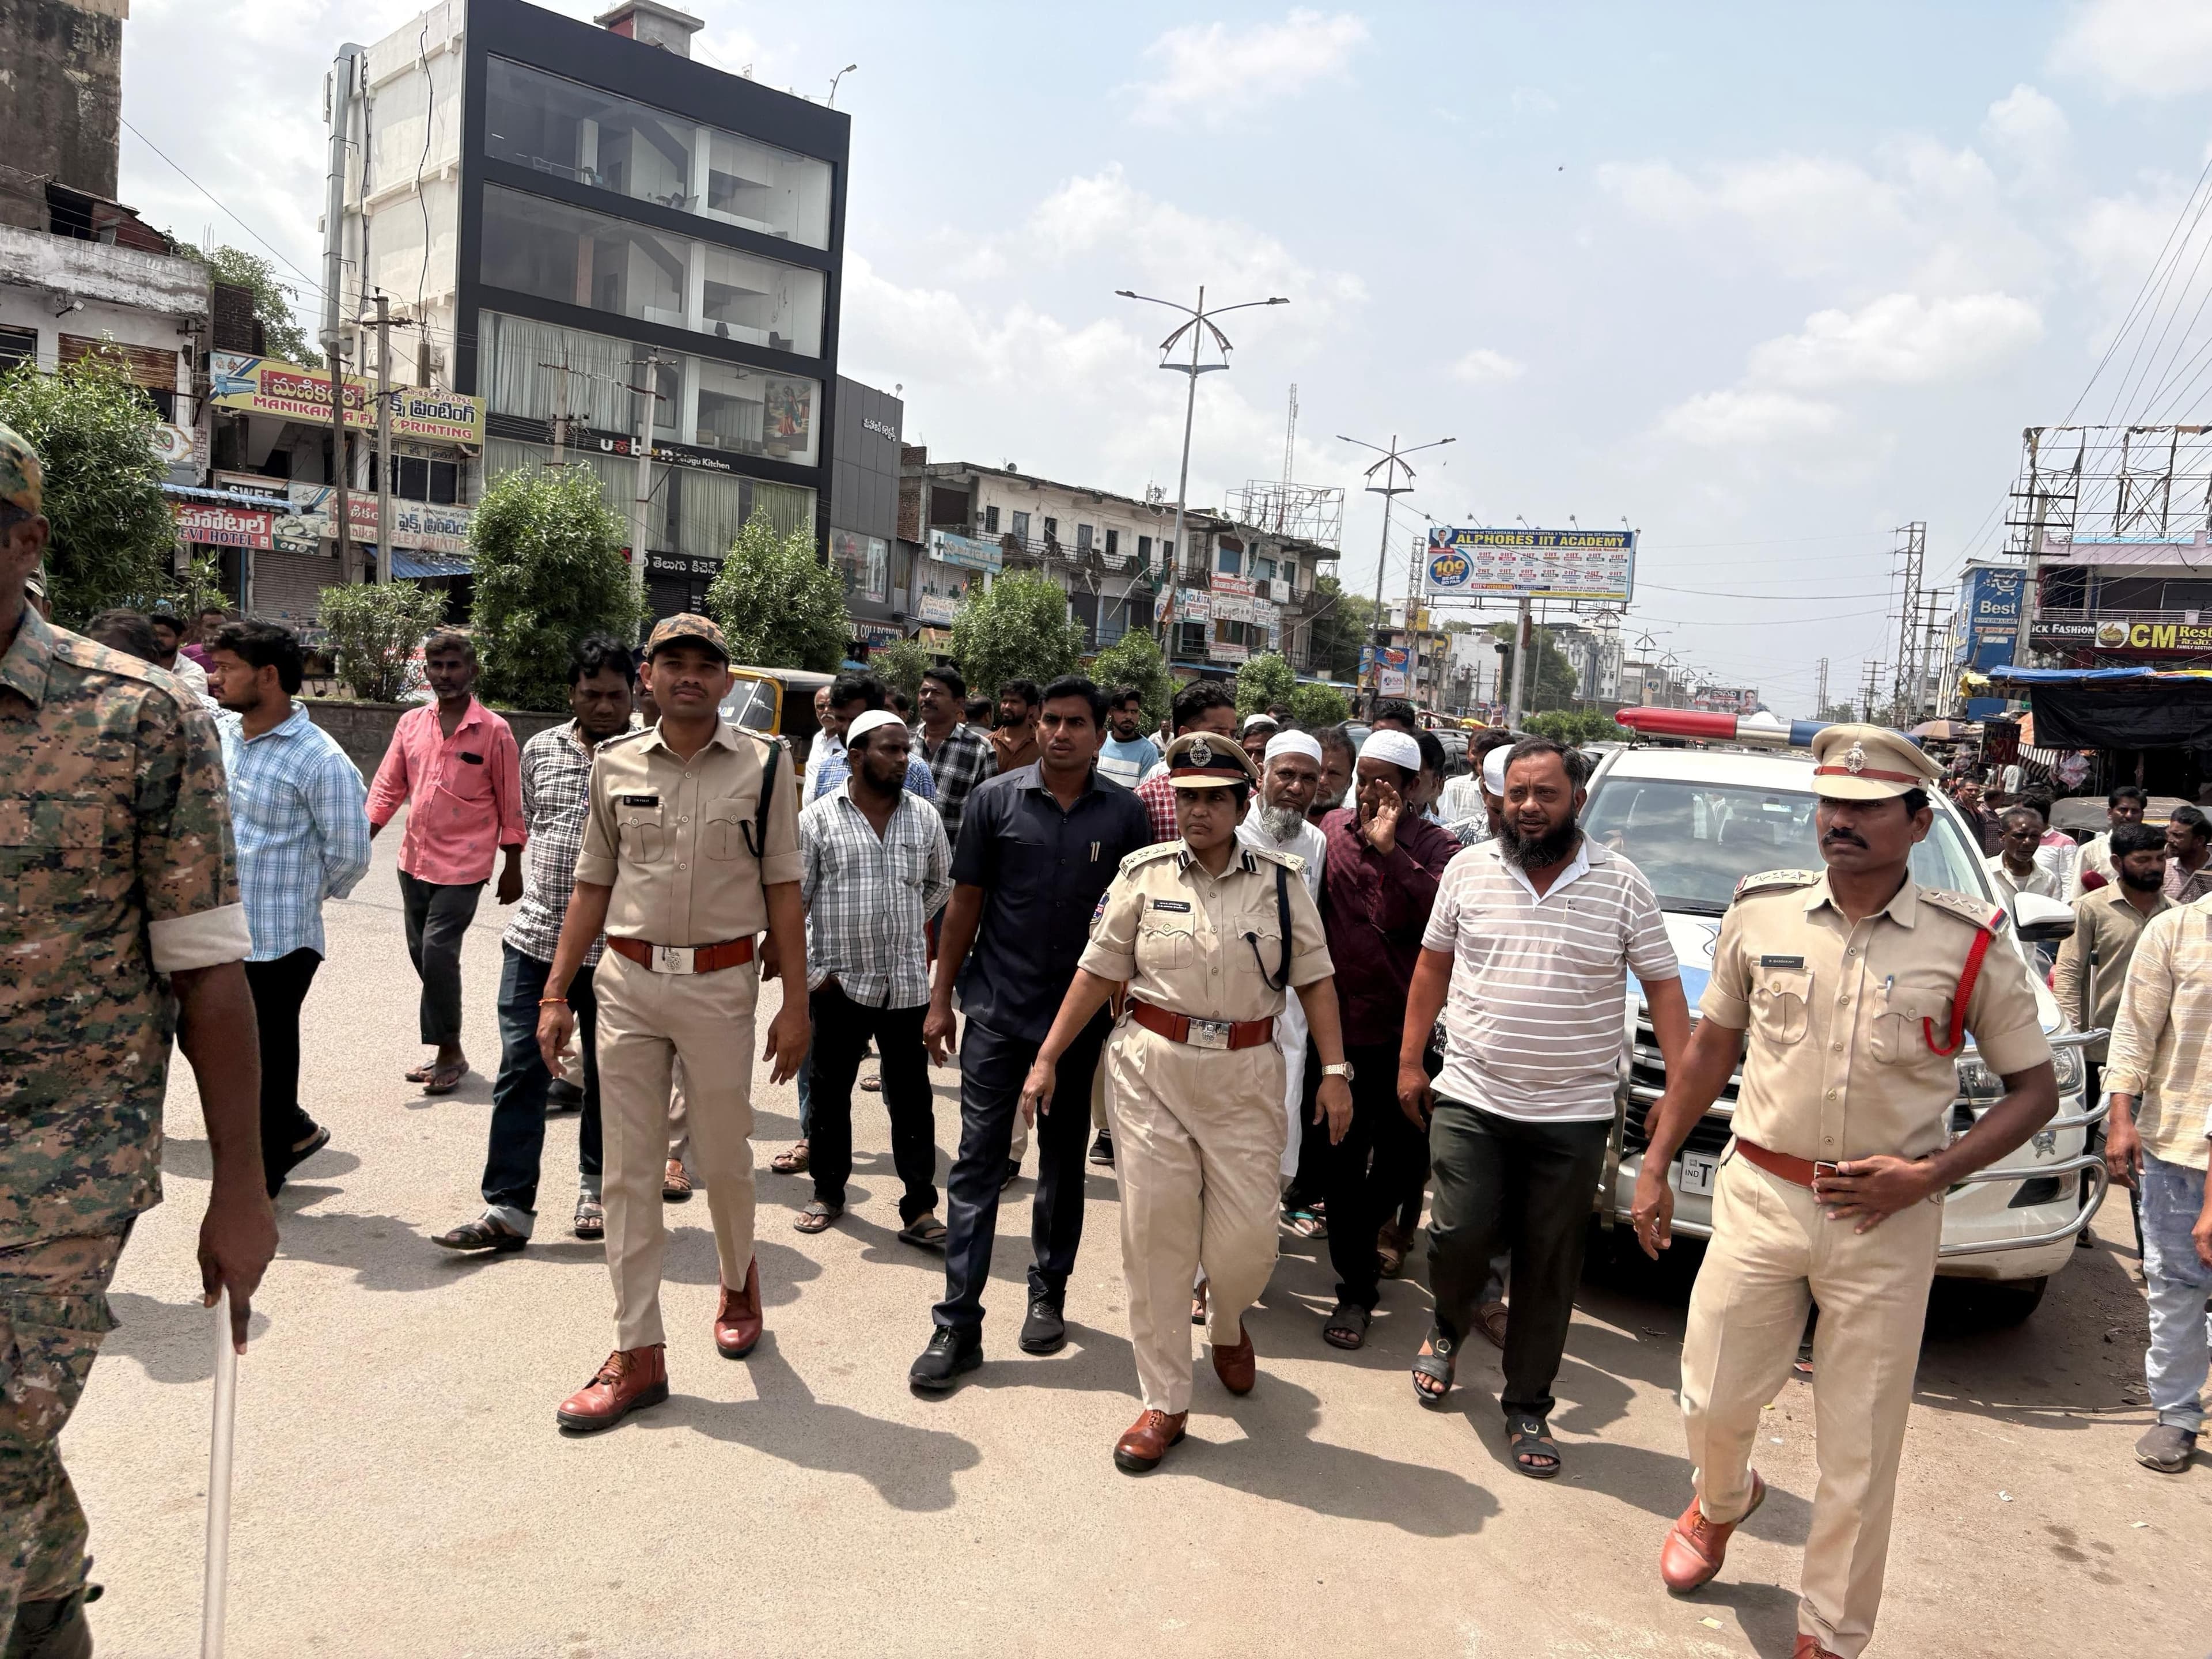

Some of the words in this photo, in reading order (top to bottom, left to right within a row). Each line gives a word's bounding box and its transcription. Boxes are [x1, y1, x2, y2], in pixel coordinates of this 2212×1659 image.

[252, 396, 353, 421] MANIKANA
[401, 421, 472, 440] PRINTING
[702, 458, 730, 470] Kitchen
[209, 531, 255, 546] HOTEL
[1456, 534, 1534, 545] ALPHORES
[1539, 536, 1556, 546] IIT
[1559, 536, 1625, 547] ACADEMY
[1434, 560, 1465, 577] 109
[1187, 594, 1210, 604] KOLKATA
[1980, 600, 2016, 614] Best
[2131, 624, 2176, 648] CM
[1685, 1169, 1699, 1177] IND
